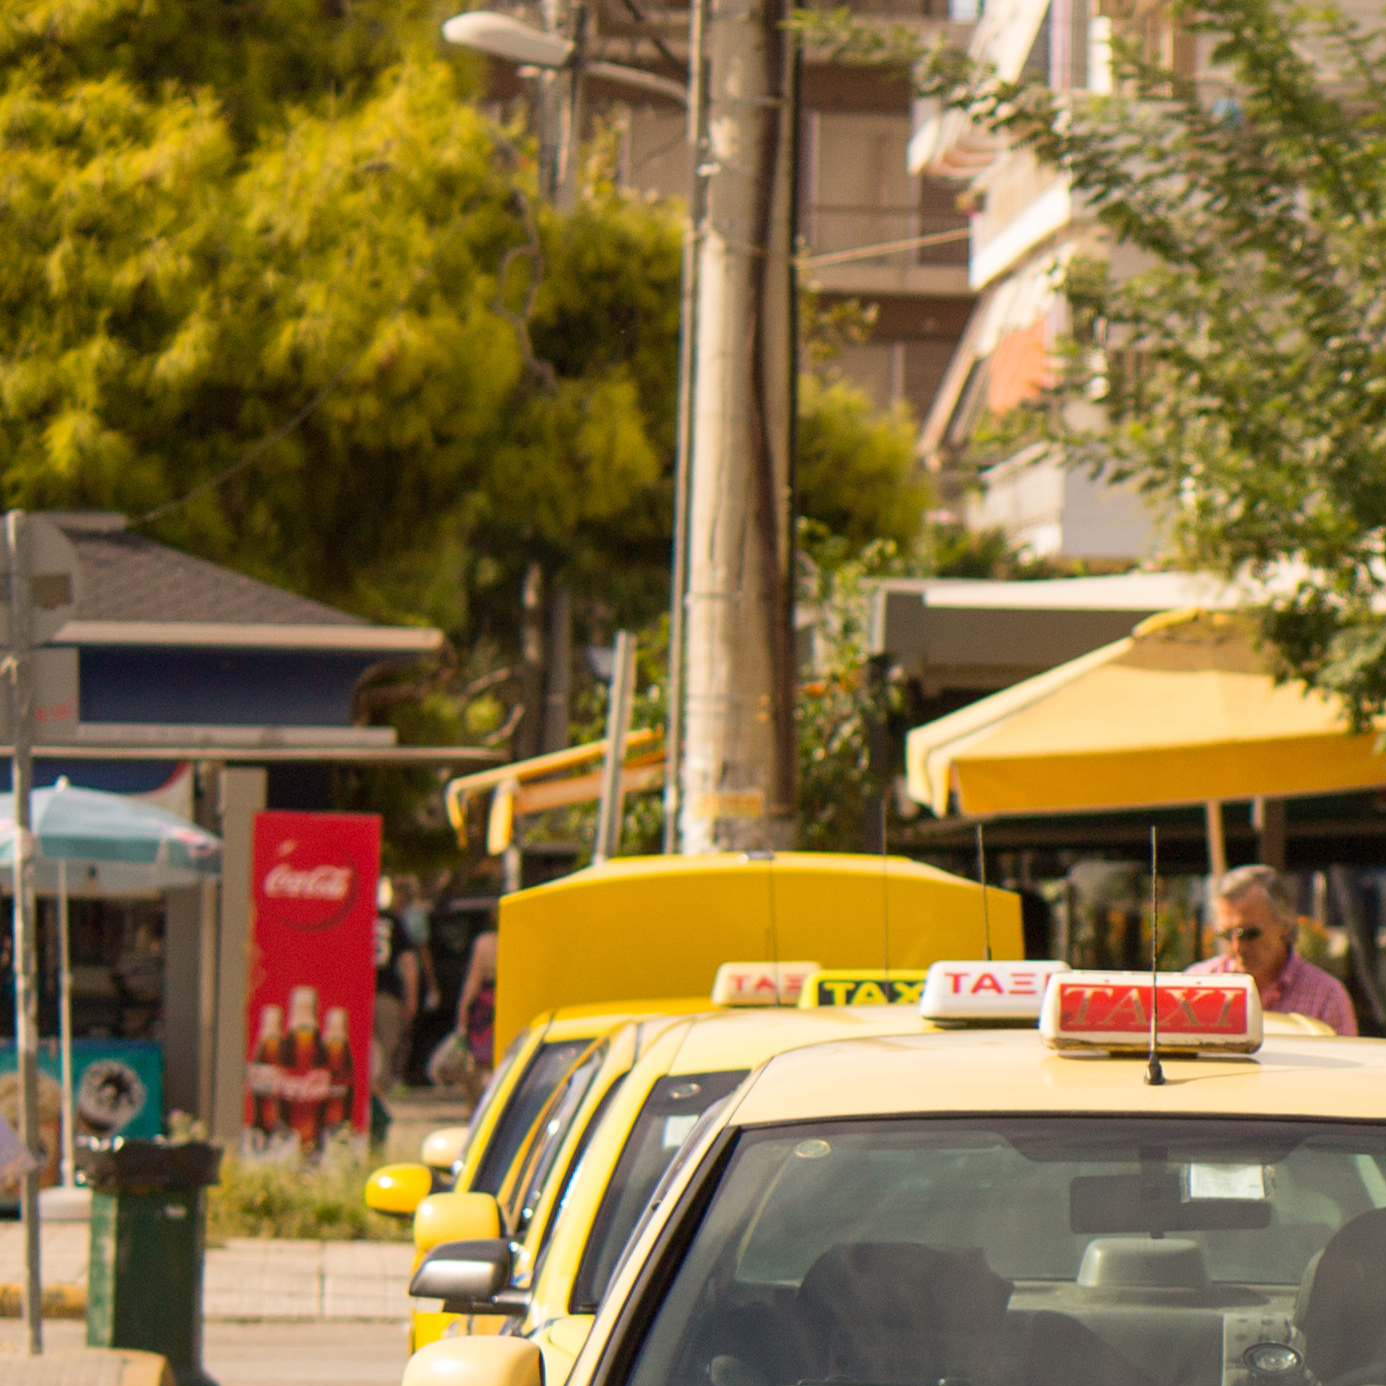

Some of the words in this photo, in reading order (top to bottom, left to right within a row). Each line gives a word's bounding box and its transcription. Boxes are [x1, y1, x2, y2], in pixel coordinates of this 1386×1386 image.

[729, 974, 806, 993] ΤΑΞ
[824, 982, 926, 1006] TAX
[1064, 987, 1243, 1028] TAXI
